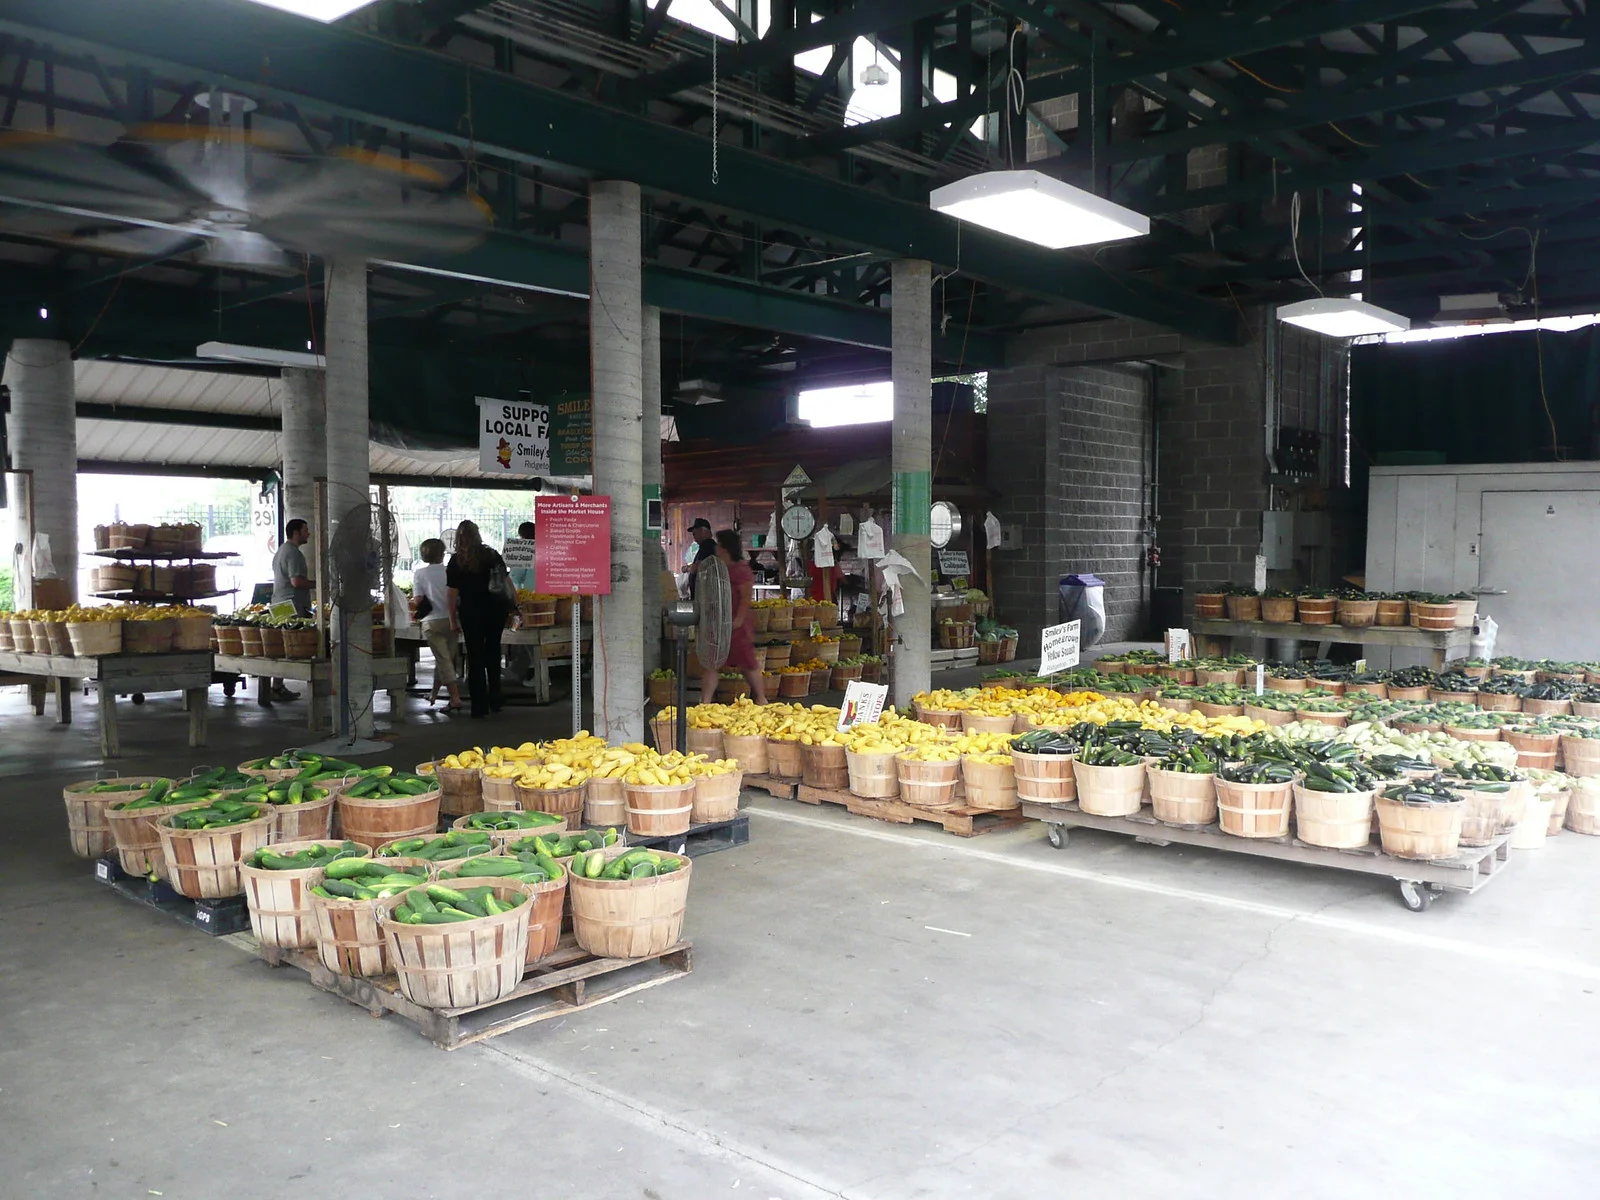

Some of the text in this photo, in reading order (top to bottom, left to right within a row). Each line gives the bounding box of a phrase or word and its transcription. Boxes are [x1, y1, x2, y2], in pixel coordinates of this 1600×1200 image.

[502, 405, 549, 424] SUPPO
[486, 420, 532, 437] LOCAL
[516, 443, 550, 460] Smiley's
[1045, 624, 1079, 638] Smiley's Farm
[854, 692, 869, 725] BANKS
[196, 910, 210, 922] iGPS
